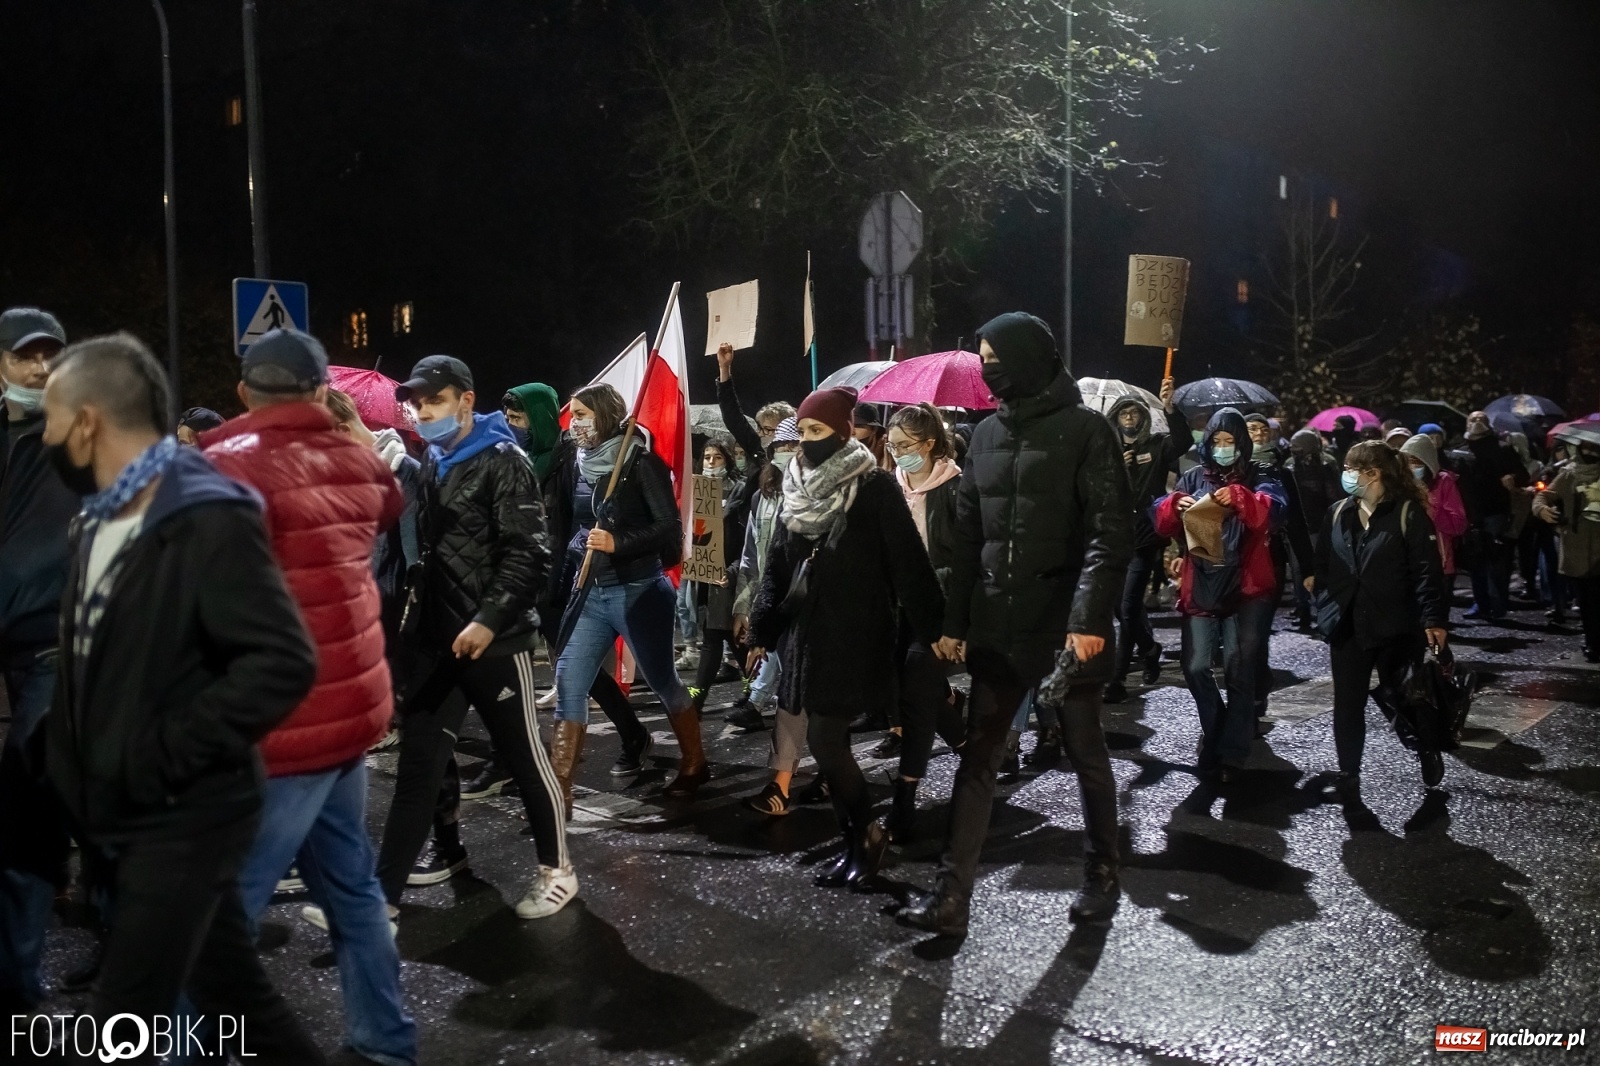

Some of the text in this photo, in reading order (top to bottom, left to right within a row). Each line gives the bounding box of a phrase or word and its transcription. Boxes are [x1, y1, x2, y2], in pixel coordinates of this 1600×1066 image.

[692, 479, 717, 499] ARE
[693, 497, 716, 516] ZKI
[690, 542, 717, 564] BAĆ
